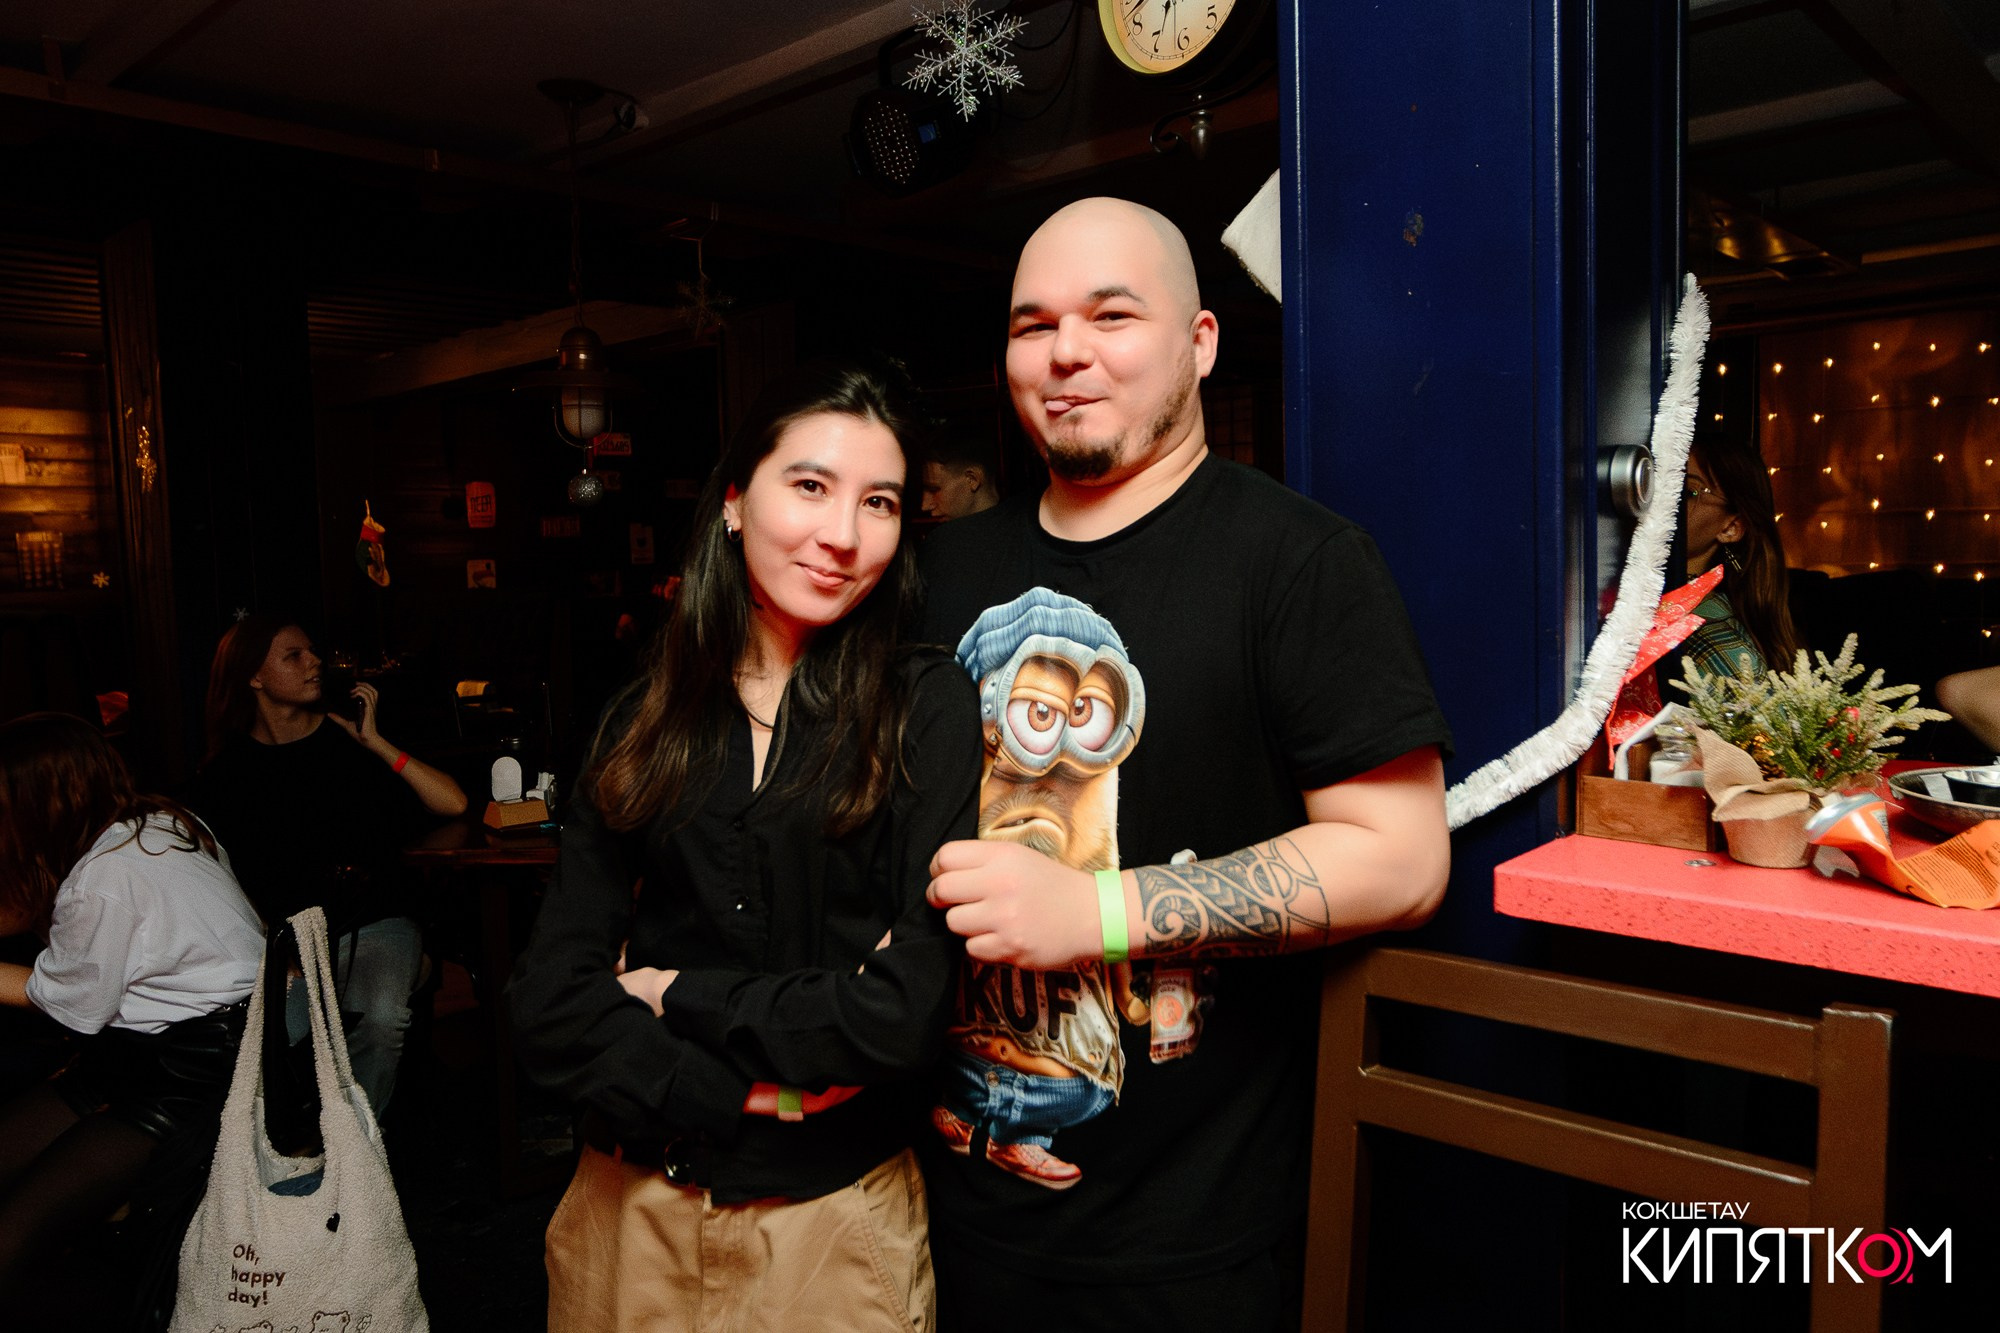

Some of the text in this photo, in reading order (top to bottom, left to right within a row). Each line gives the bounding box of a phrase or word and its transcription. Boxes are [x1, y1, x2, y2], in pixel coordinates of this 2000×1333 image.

[1132, 13, 1143, 35] 8
[1206, 5, 1217, 29] 5
[1152, 30, 1162, 52] 7
[1178, 28, 1189, 50] 6
[233, 1244, 259, 1265] Oh,
[231, 1265, 286, 1287] happy
[228, 1287, 269, 1308] day!
